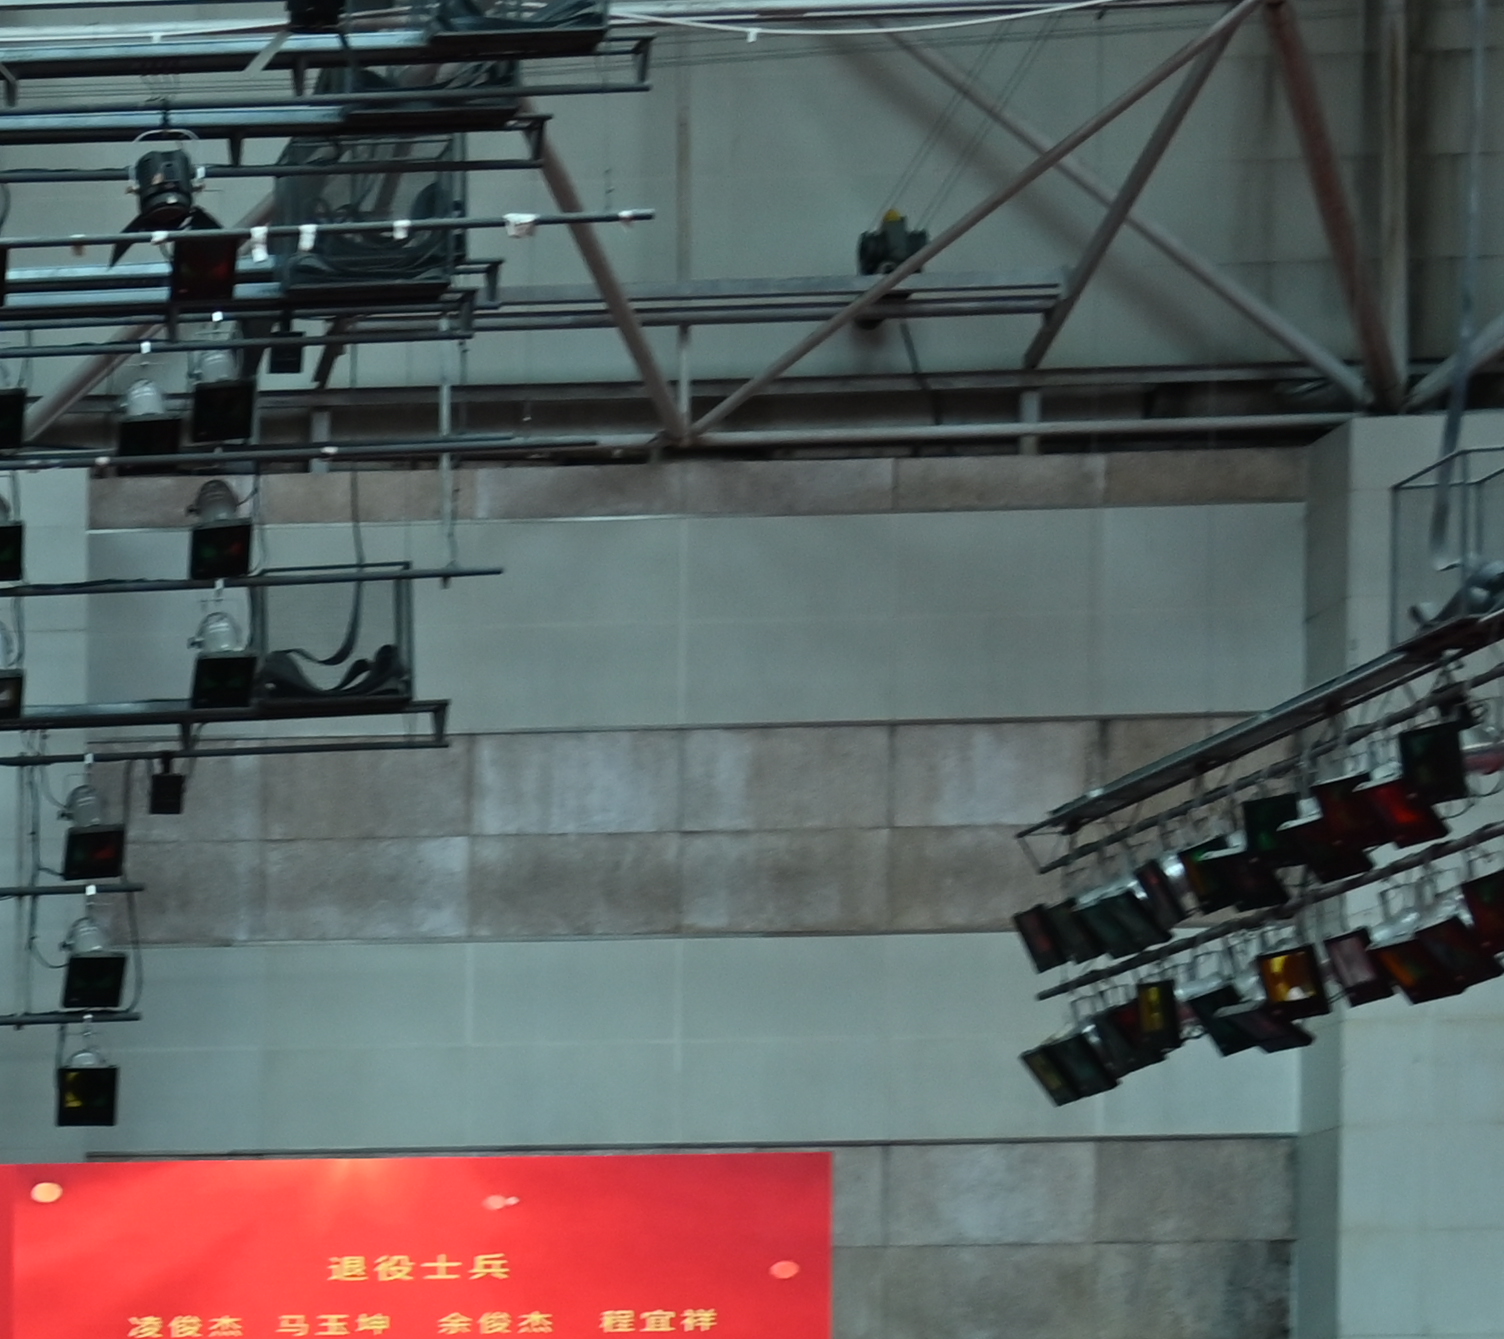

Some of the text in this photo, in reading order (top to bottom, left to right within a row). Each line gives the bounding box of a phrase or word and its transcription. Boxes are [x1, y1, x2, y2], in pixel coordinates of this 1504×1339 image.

[327, 1253, 510, 1282] 退役士兵
[276, 1313, 390, 1337] 马玉坤
[438, 1311, 553, 1335] 余俊杰
[599, 1308, 717, 1333] 程宜祥
